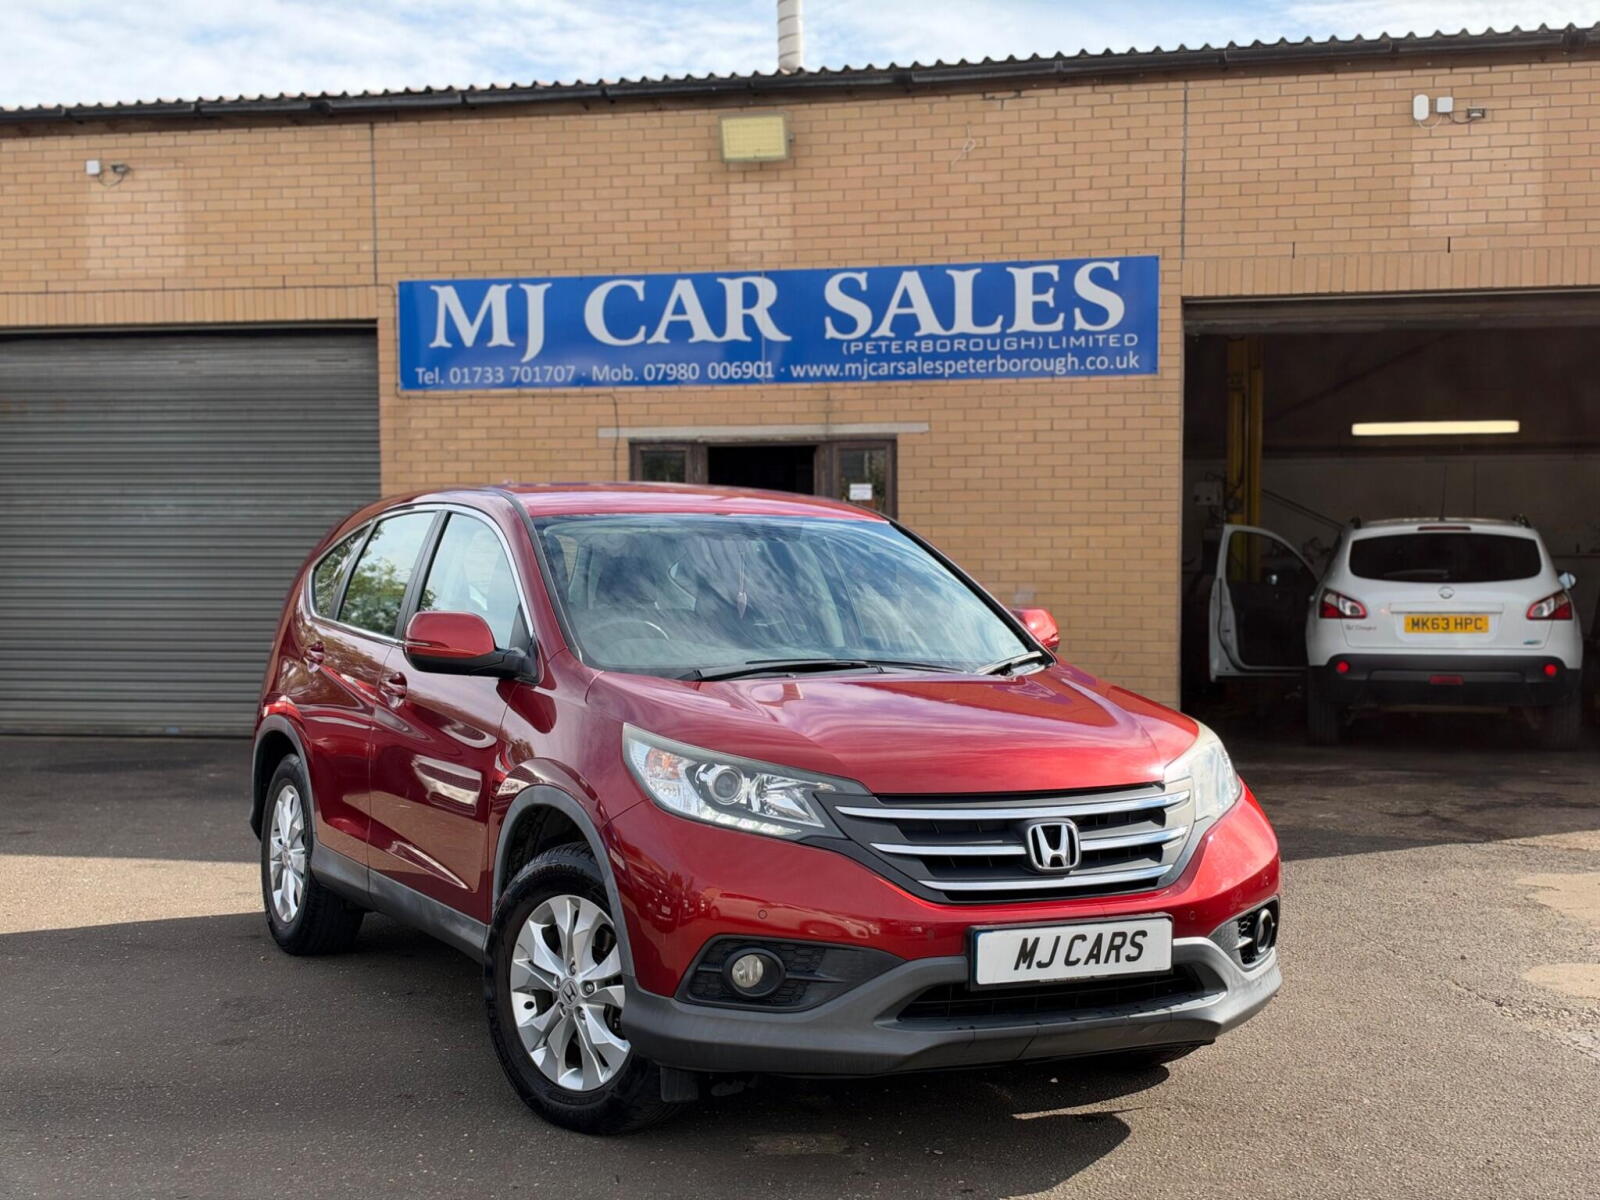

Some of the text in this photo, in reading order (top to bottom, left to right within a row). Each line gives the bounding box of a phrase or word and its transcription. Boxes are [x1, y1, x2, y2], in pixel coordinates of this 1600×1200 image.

[429, 261, 1125, 363] MJ CAR SALES
[842, 333, 1138, 355] (PETERBOROUGH) LIMITED
[415, 351, 1139, 385] Tel. 01733 701707 Mob. 07980 006901 www.mjcarsalespeterborough.co.uk
[1411, 616, 1484, 631] MK63 HPC
[1013, 930, 1148, 970] MJ CARS
